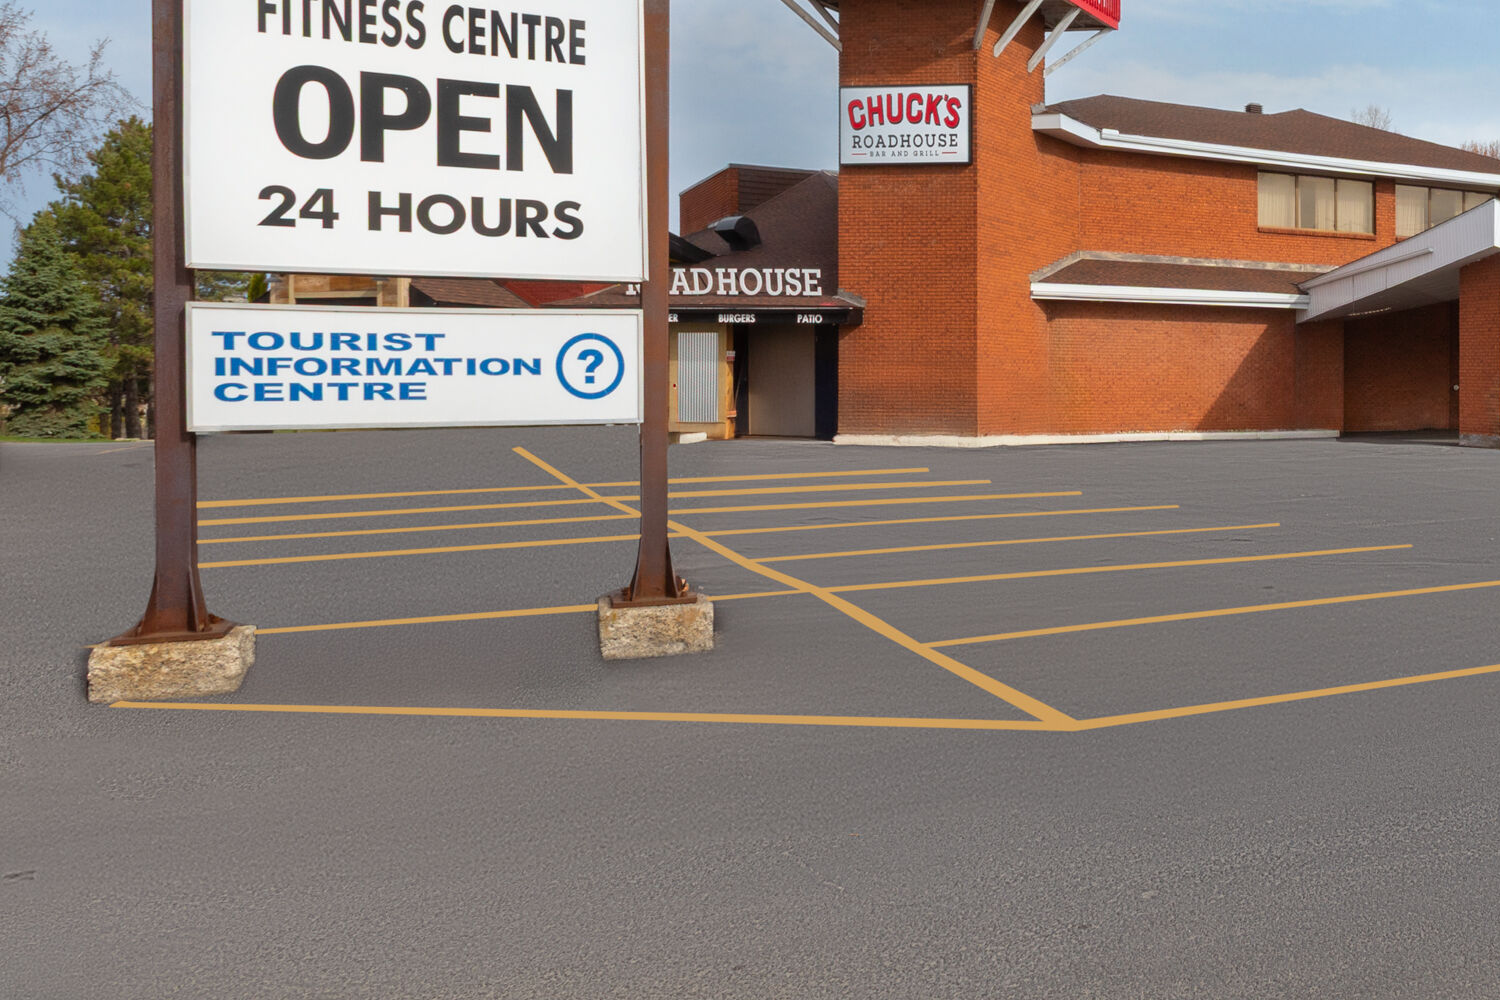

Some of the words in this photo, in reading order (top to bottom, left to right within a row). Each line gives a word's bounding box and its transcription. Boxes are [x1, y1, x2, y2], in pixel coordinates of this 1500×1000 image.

[442, 4, 586, 66] CENTRE
[272, 65, 573, 175] OPEN
[847, 92, 962, 131] CHUCK'S
[851, 133, 958, 149] ROADHOUSE
[257, 185, 339, 229] 24
[368, 190, 584, 240] HOURS
[718, 313, 756, 324] BURGERS
[797, 313, 823, 324] PATIO
[211, 331, 446, 352] TOURIST
[214, 356, 542, 377] INFORMATION
[213, 382, 427, 402] CENTRE
